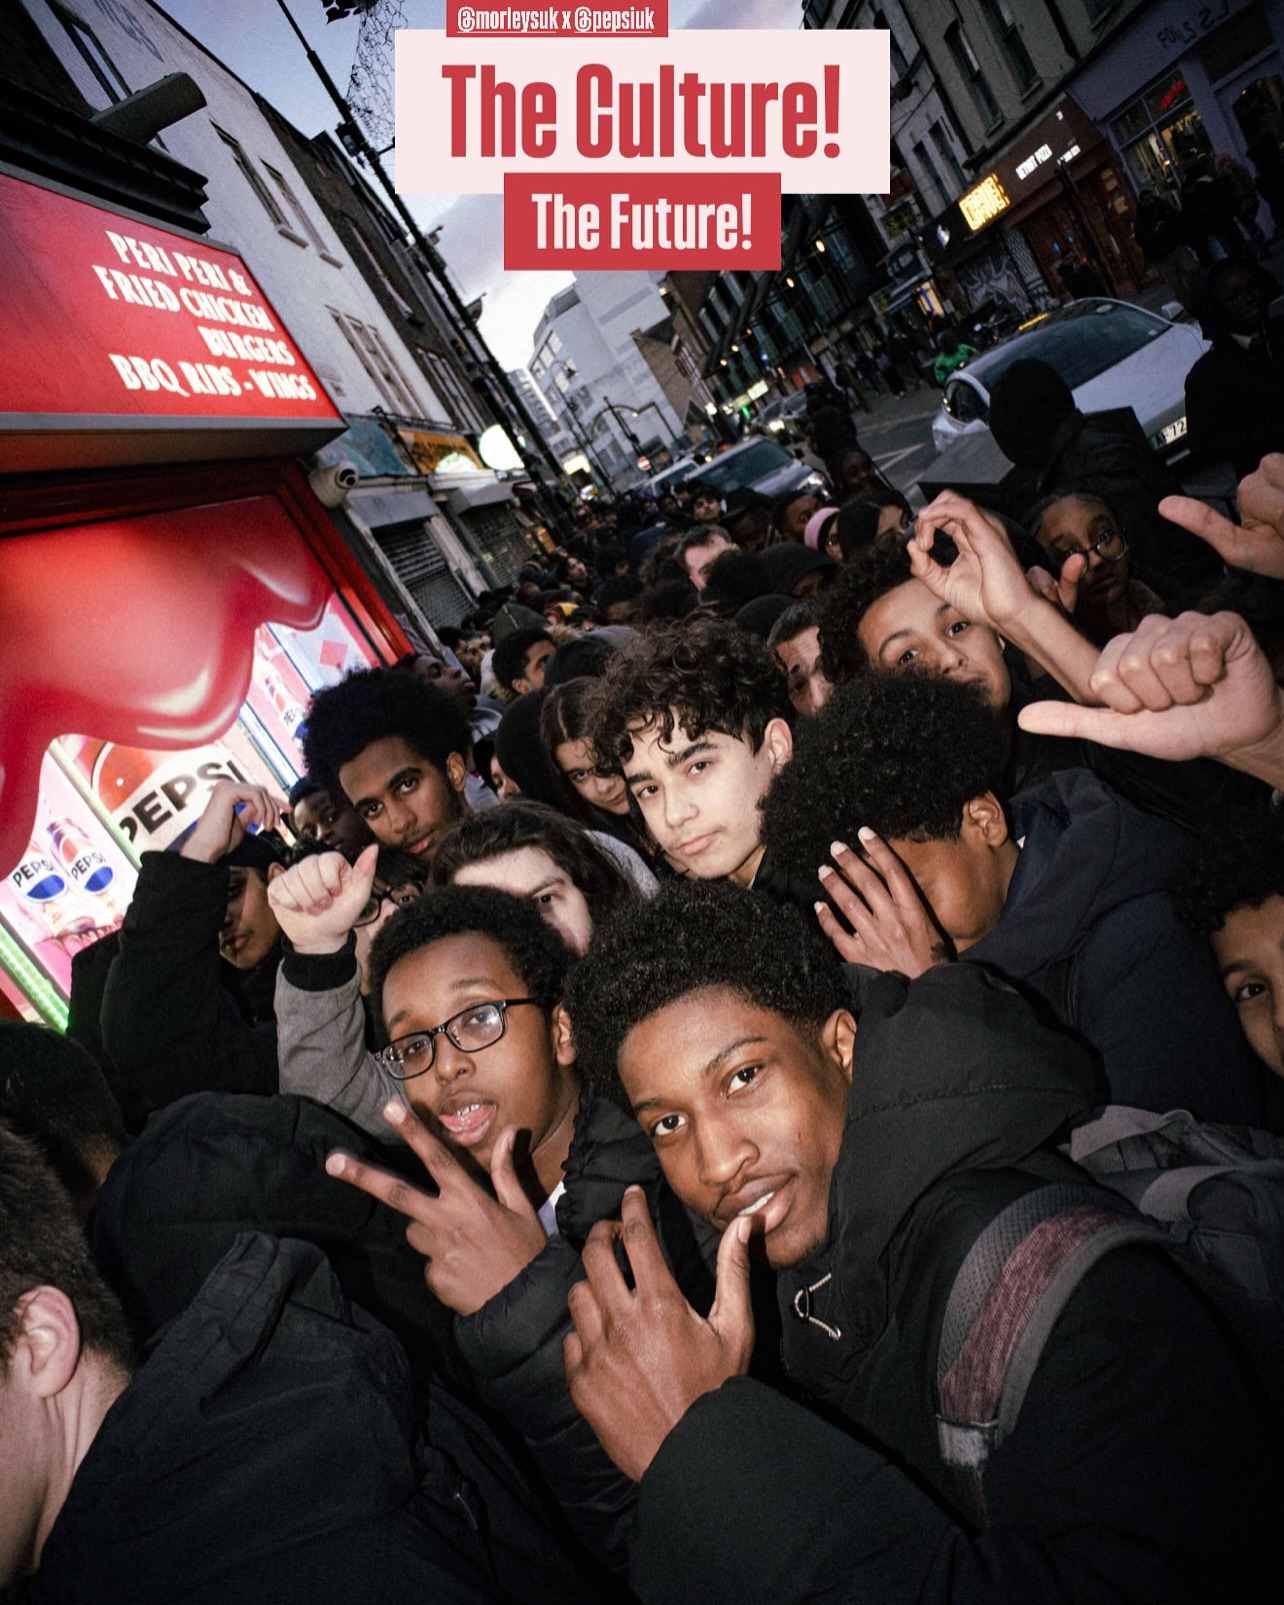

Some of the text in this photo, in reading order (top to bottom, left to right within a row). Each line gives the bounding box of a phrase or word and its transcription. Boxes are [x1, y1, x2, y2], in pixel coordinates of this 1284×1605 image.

[106, 230, 252, 296] PERI PERI &
[92, 264, 275, 333] FRIED CHICKEN
[198, 325, 295, 366] BURGERS
[109, 353, 190, 398] BBQ
[179, 361, 243, 397] RIBS
[249, 369, 317, 401] WINGS
[12, 859, 56, 888] PEPS
